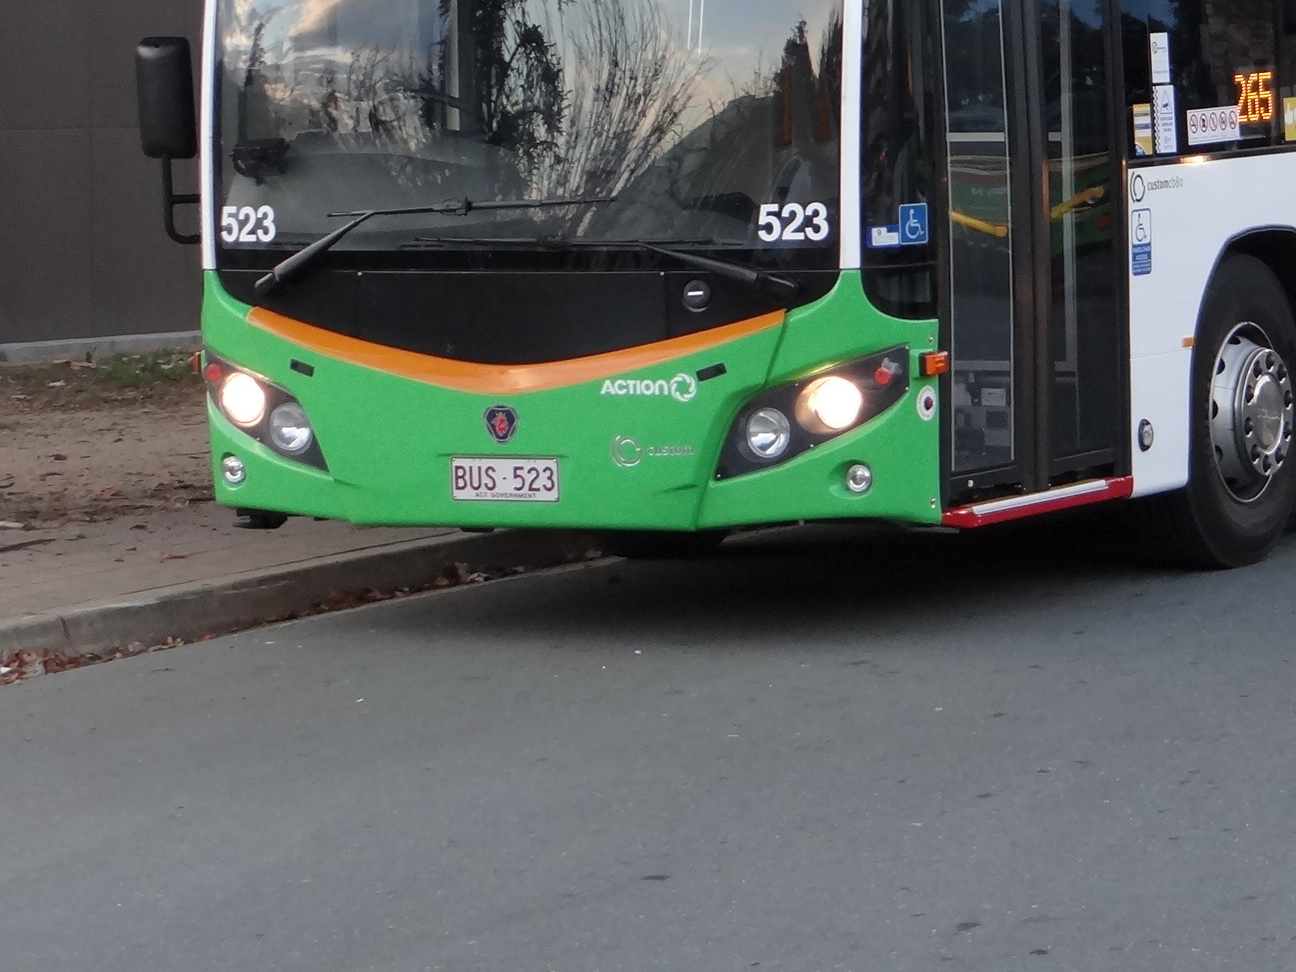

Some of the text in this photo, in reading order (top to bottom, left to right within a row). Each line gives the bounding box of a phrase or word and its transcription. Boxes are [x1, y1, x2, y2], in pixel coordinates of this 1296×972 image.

[1234, 71, 1273, 123] 265
[220, 204, 277, 243] 523
[757, 201, 830, 242] 523
[600, 379, 669, 396] ACTION
[454, 464, 556, 493] BUS 523
[475, 491, 537, 501] ACT GOVERNMENT
